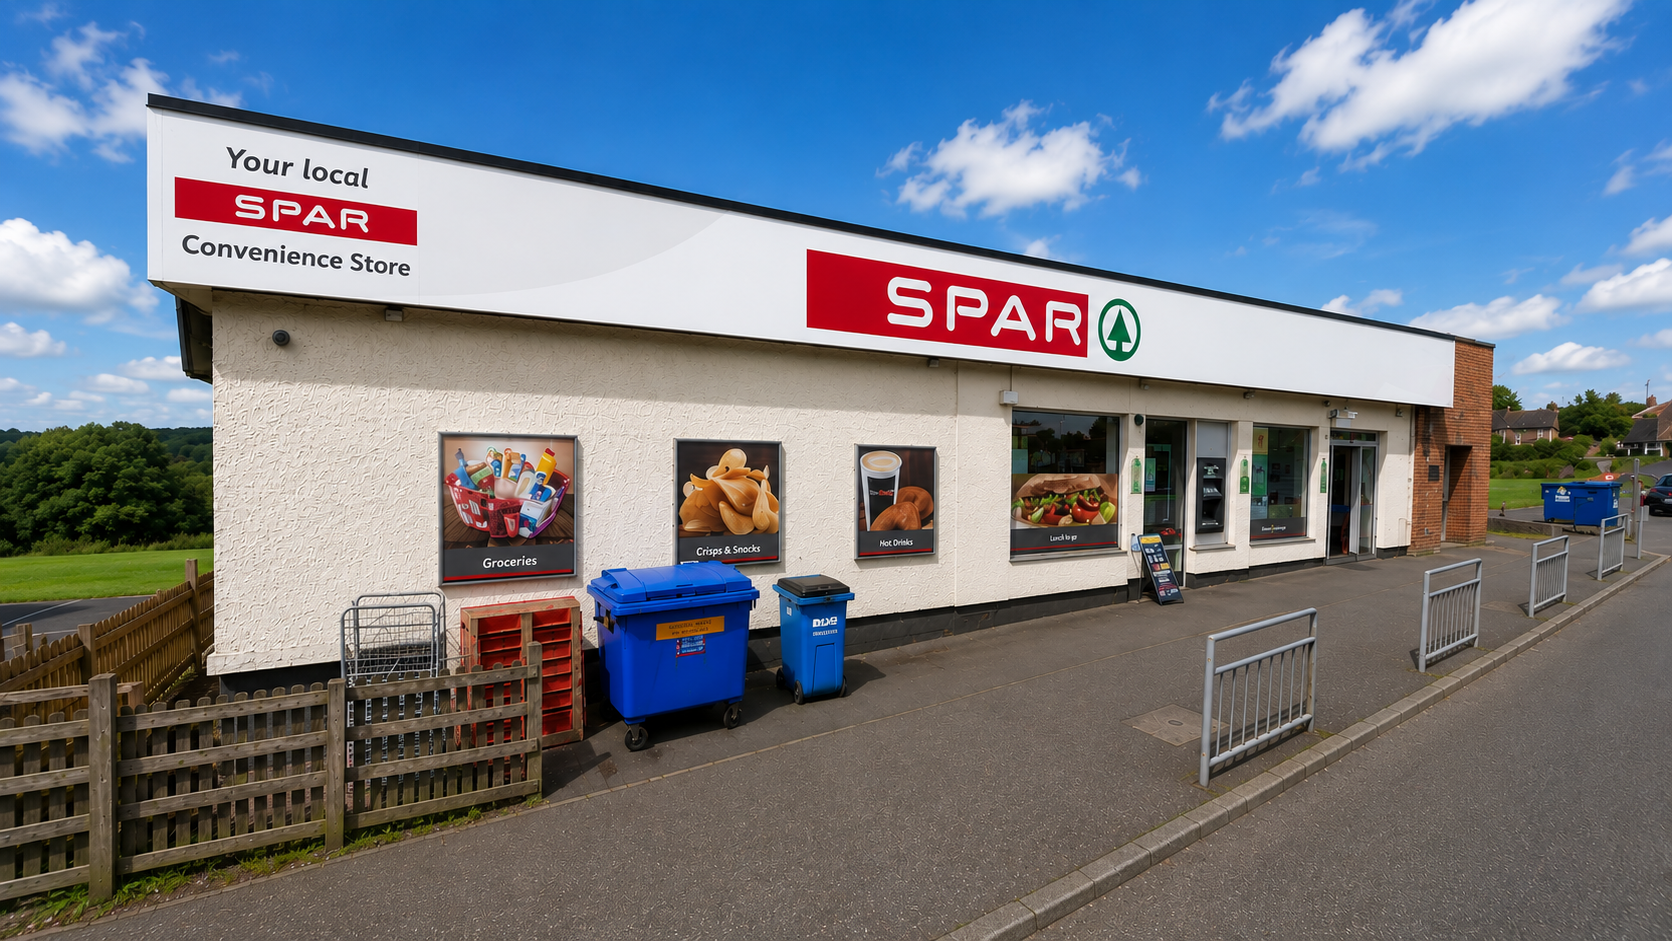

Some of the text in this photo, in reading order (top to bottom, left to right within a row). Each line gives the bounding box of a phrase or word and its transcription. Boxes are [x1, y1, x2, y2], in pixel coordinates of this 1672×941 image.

[226, 146, 369, 189] Your local
[234, 194, 370, 234] SPAR
[181, 234, 412, 277] Convenience Store
[886, 276, 1082, 346] SPAR
[482, 555, 538, 569] Groceries
[696, 546, 723, 558] Crisps
[723, 545, 732, 555] &
